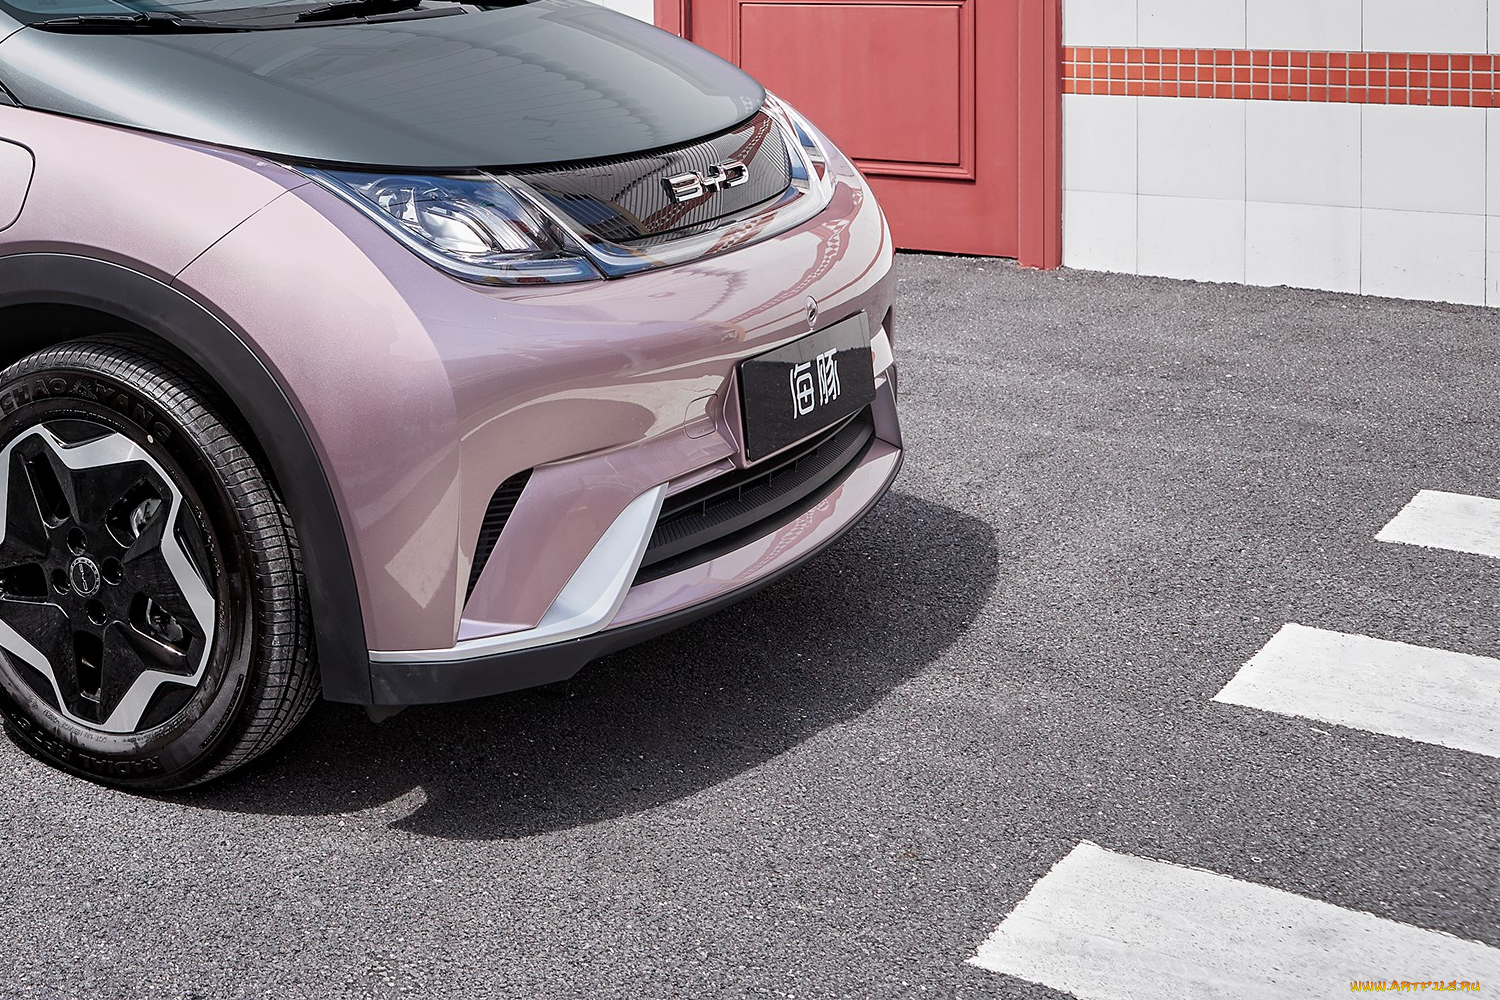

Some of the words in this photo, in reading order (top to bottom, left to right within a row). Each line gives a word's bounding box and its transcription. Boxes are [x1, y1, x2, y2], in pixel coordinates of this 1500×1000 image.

[661, 159, 750, 203] BYD
[1, 376, 69, 414] CHAO
[94, 380, 173, 442] YANG
[789, 347, 841, 420] 海豚
